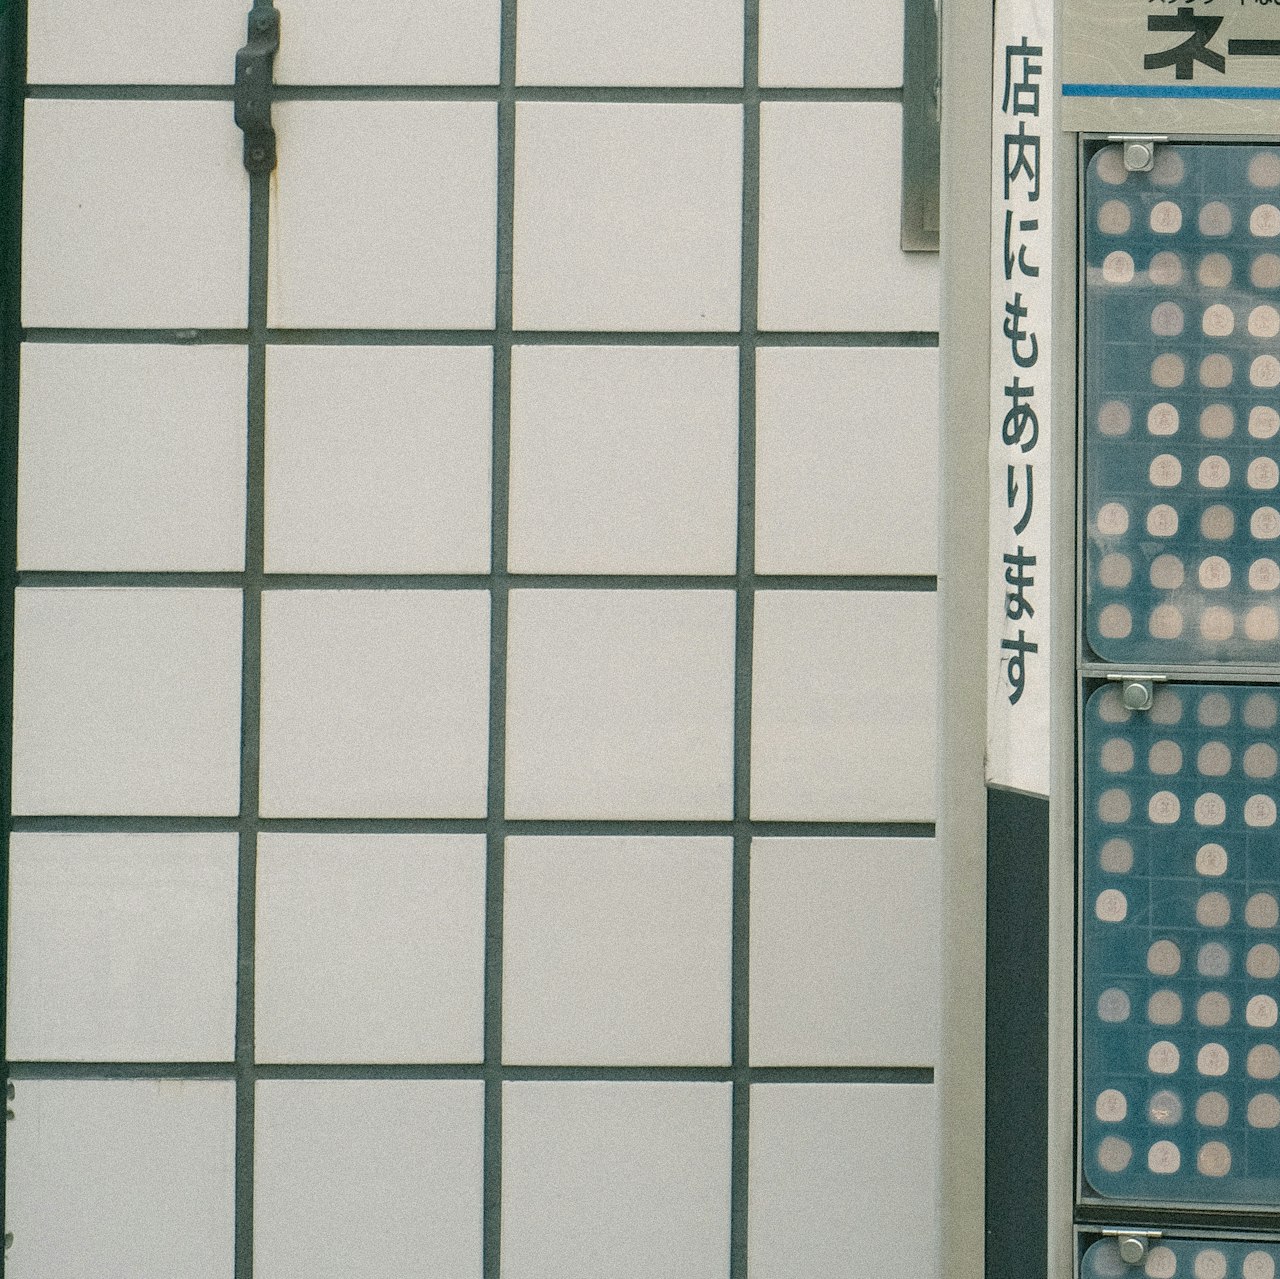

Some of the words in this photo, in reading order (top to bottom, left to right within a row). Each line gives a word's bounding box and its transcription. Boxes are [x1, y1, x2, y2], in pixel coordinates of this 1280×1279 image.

[1000, 36, 1043, 706] 店内にもあります
